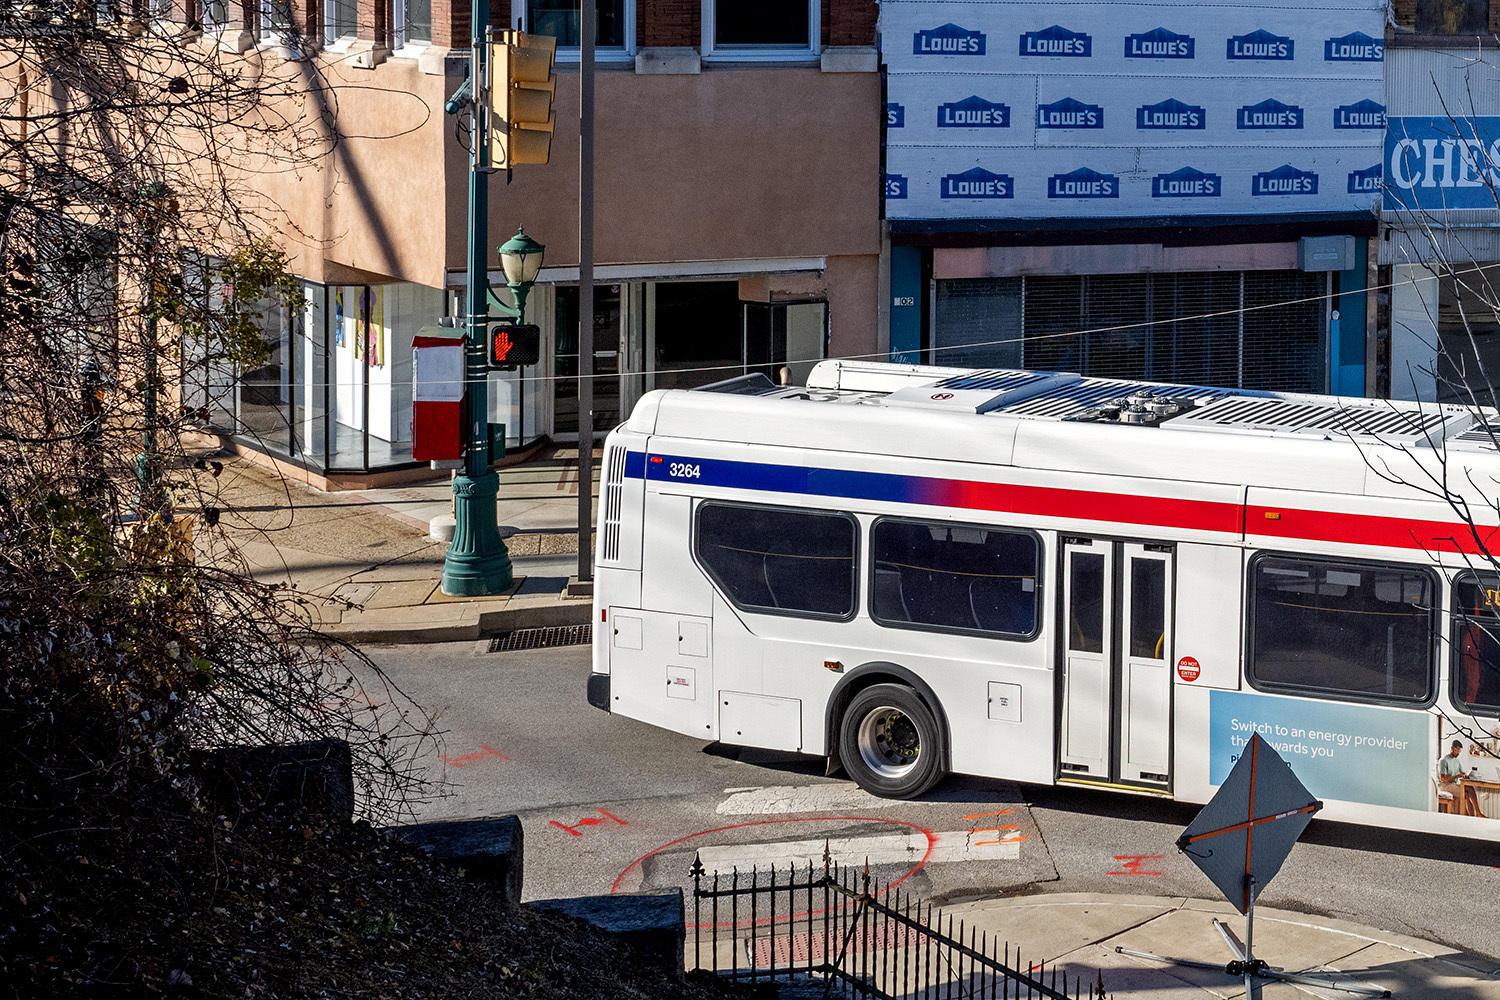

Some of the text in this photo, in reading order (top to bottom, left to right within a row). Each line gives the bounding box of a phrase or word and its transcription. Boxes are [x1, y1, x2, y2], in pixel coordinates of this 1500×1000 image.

[922, 36, 979, 52] LOWE'S
[1027, 38, 1084, 54] LOWE'S
[1133, 39, 1188, 55] LOWE'S
[1235, 41, 1288, 57] LOWE'S
[1332, 43, 1383, 58] LOWE'S
[946, 108, 1003, 124] LOWE'S
[1040, 110, 1097, 125] LOWE'S
[1145, 111, 1199, 126] LOWE'S
[1245, 111, 1297, 126] LOWE'S
[949, 180, 1006, 195] LOWE'S
[1056, 180, 1112, 195] LOWE'S
[1160, 179, 1214, 194] LOWE'S
[1260, 178, 1312, 192] LOWE'S
[669, 462, 701, 479] 3264
[1231, 718, 1408, 751] Switch to an energy provider
[1231, 734, 1249, 748] tha
[1310, 746, 1334, 759] you
